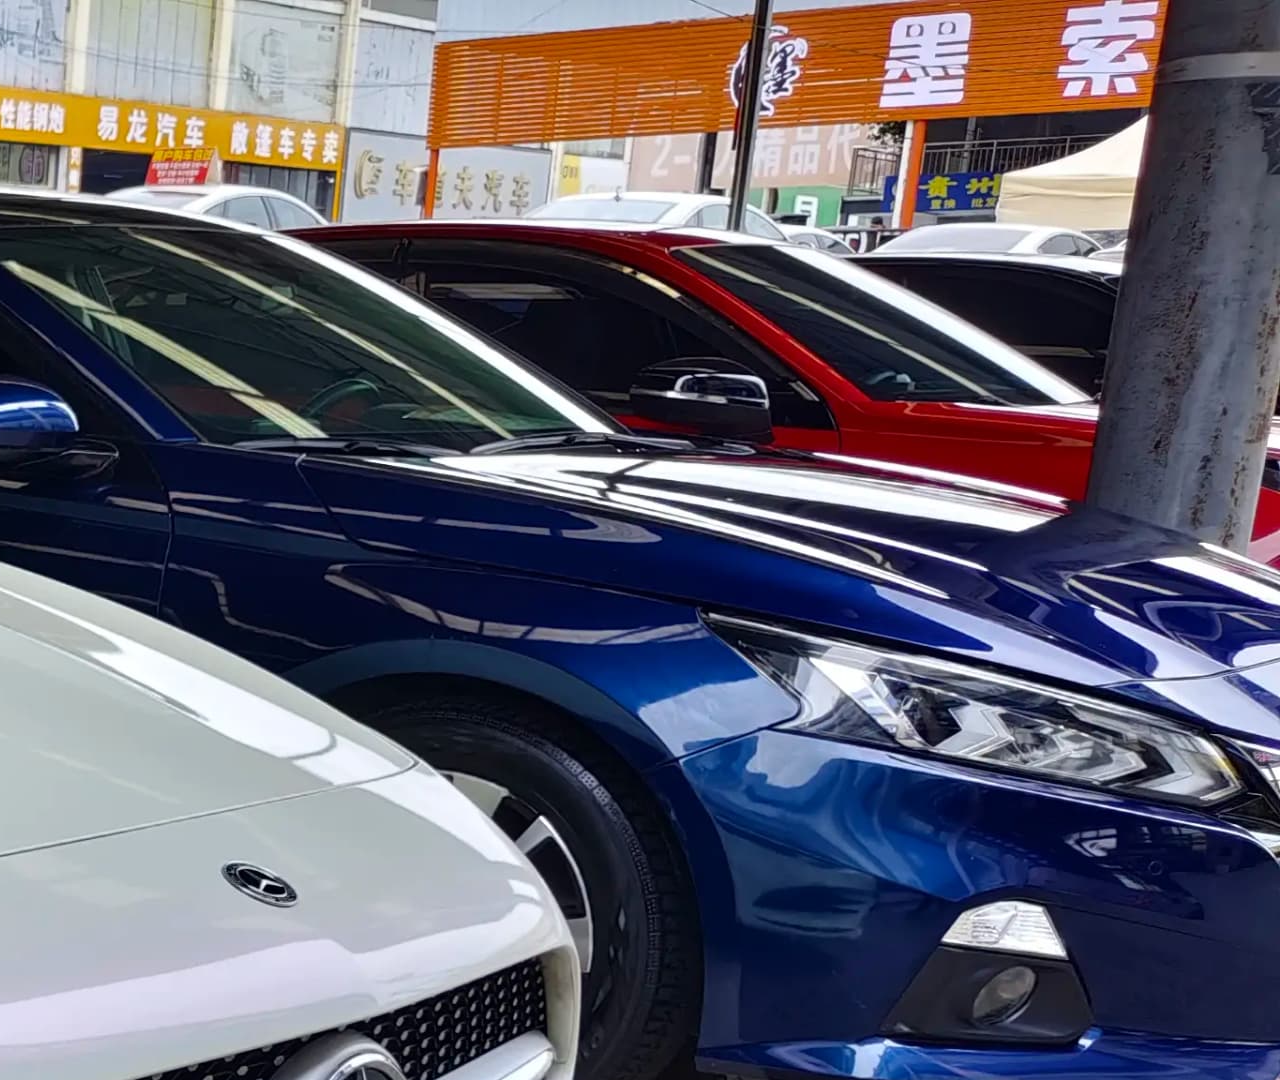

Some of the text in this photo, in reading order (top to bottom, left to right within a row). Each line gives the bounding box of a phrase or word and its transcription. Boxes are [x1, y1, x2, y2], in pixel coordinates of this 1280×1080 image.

[879, 0, 1159, 108] 墨索
[97, 104, 206, 149] 易龙汽车
[230, 120, 339, 165] 敞篷车专卖
[918, 173, 1003, 199] 贵州
